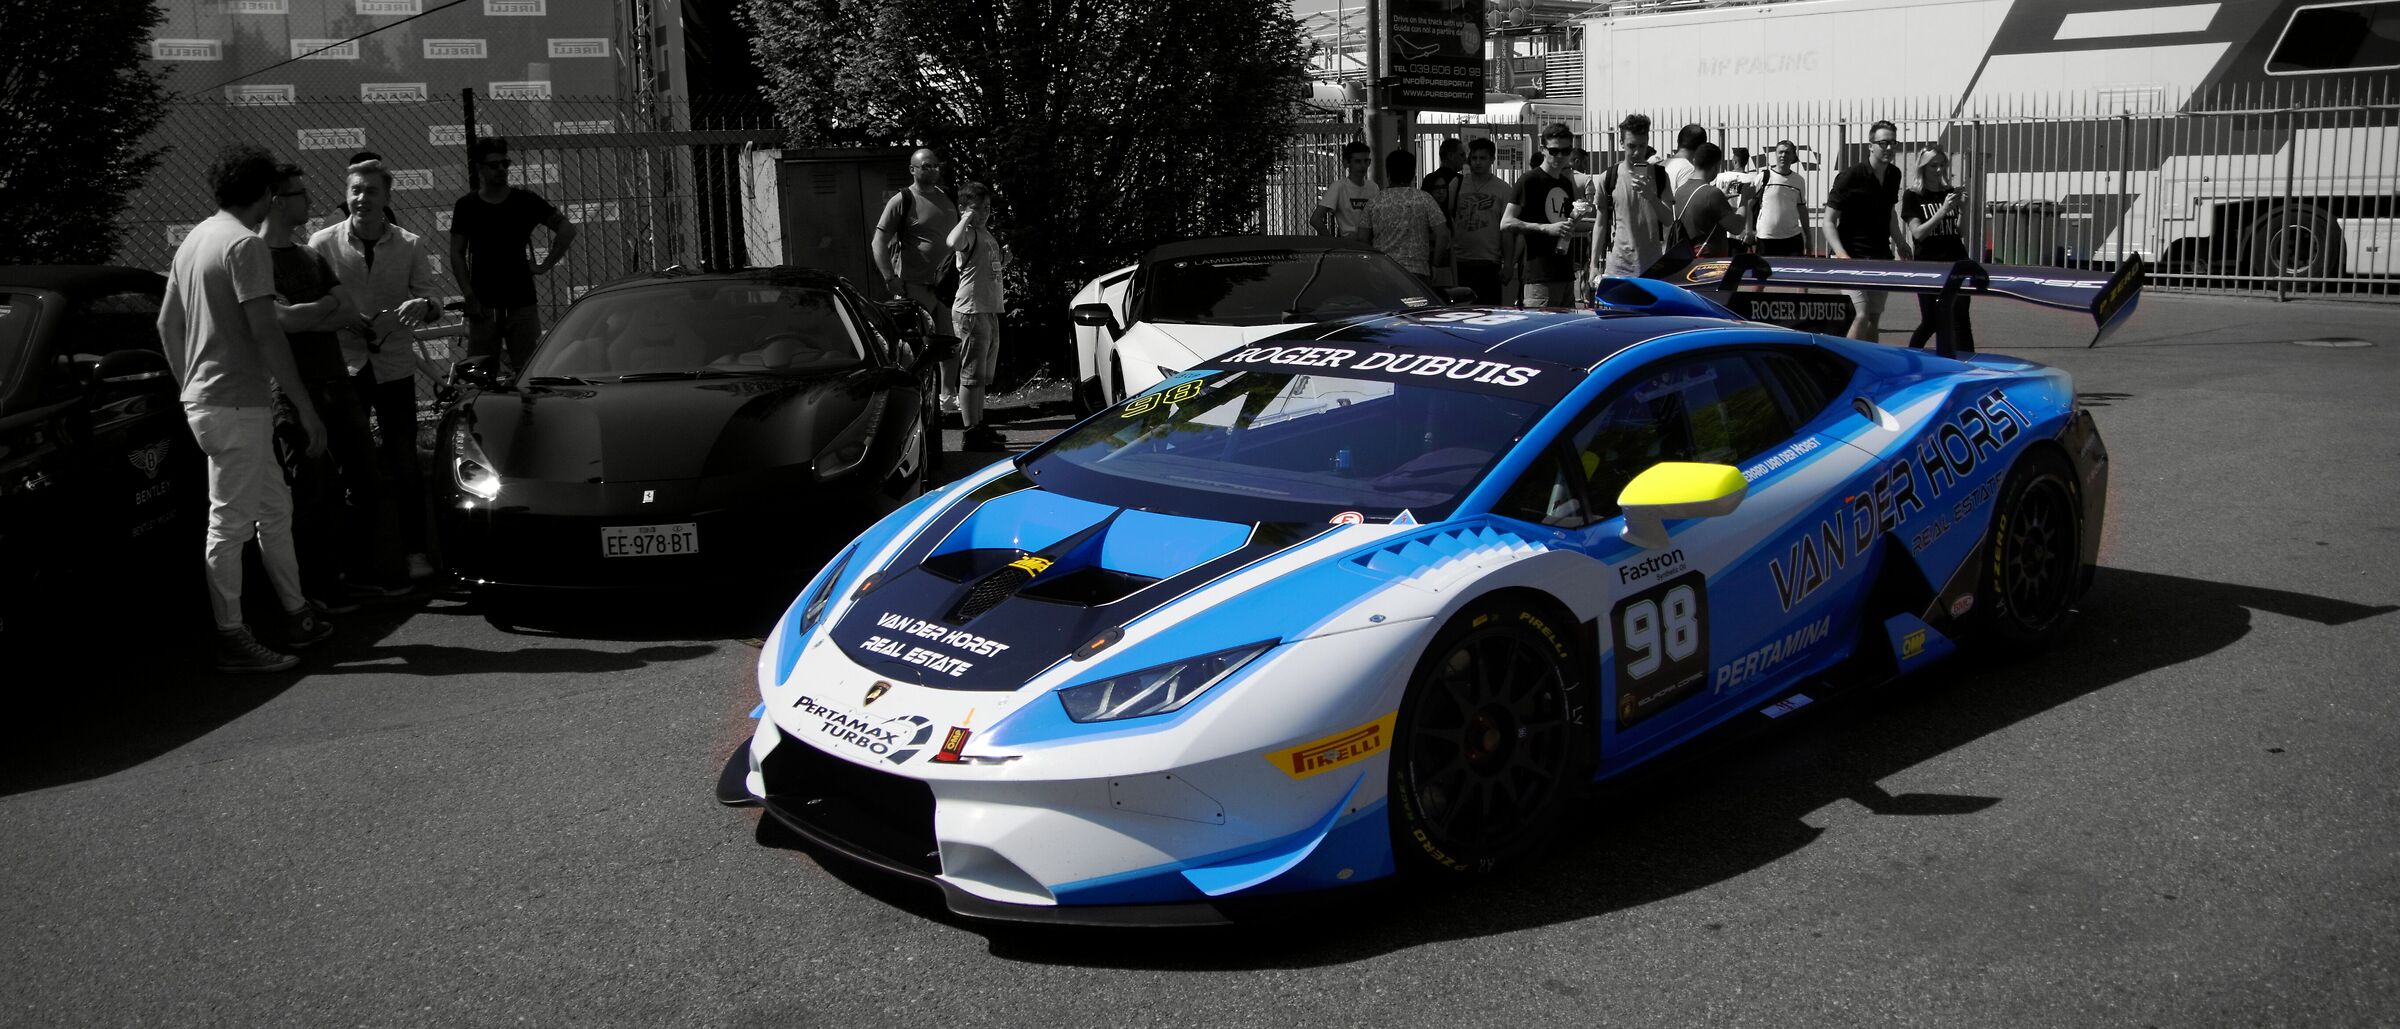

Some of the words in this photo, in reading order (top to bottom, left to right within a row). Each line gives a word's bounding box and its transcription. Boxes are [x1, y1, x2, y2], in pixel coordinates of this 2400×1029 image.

[1393, 65, 1407, 73] TEL
[1734, 50, 1819, 75] RACING
[1402, 89, 1474, 99] WWW.PURESPORT.IT
[1988, 275, 2108, 289] ORSE
[1750, 300, 1796, 321] ROGER
[1799, 301, 1847, 321] DUBUIS
[1220, 345, 1356, 368] ROGER
[1350, 350, 1542, 388] DUBUIS
[1120, 379, 1204, 419] 98
[135, 480, 171, 505] BENTLEY
[1768, 509, 1846, 613] VAN
[1852, 458, 1926, 557] DER
[1916, 387, 2032, 500] HORST
[1912, 513, 1952, 558] REAL
[1618, 549, 1685, 585] Fastron
[876, 612, 914, 631] VAN
[910, 620, 948, 641] DER
[940, 630, 1011, 658] HORST
[1519, 610, 1569, 660] PIRELLI
[1622, 584, 1699, 681] 98
[859, 635, 907, 658] REAL
[901, 647, 974, 677] ESTATE
[1714, 615, 1831, 696] PERTAMINA
[792, 695, 900, 745] PERTAMAX
[820, 721, 889, 755] TURBO
[946, 729, 963, 750] OMP
